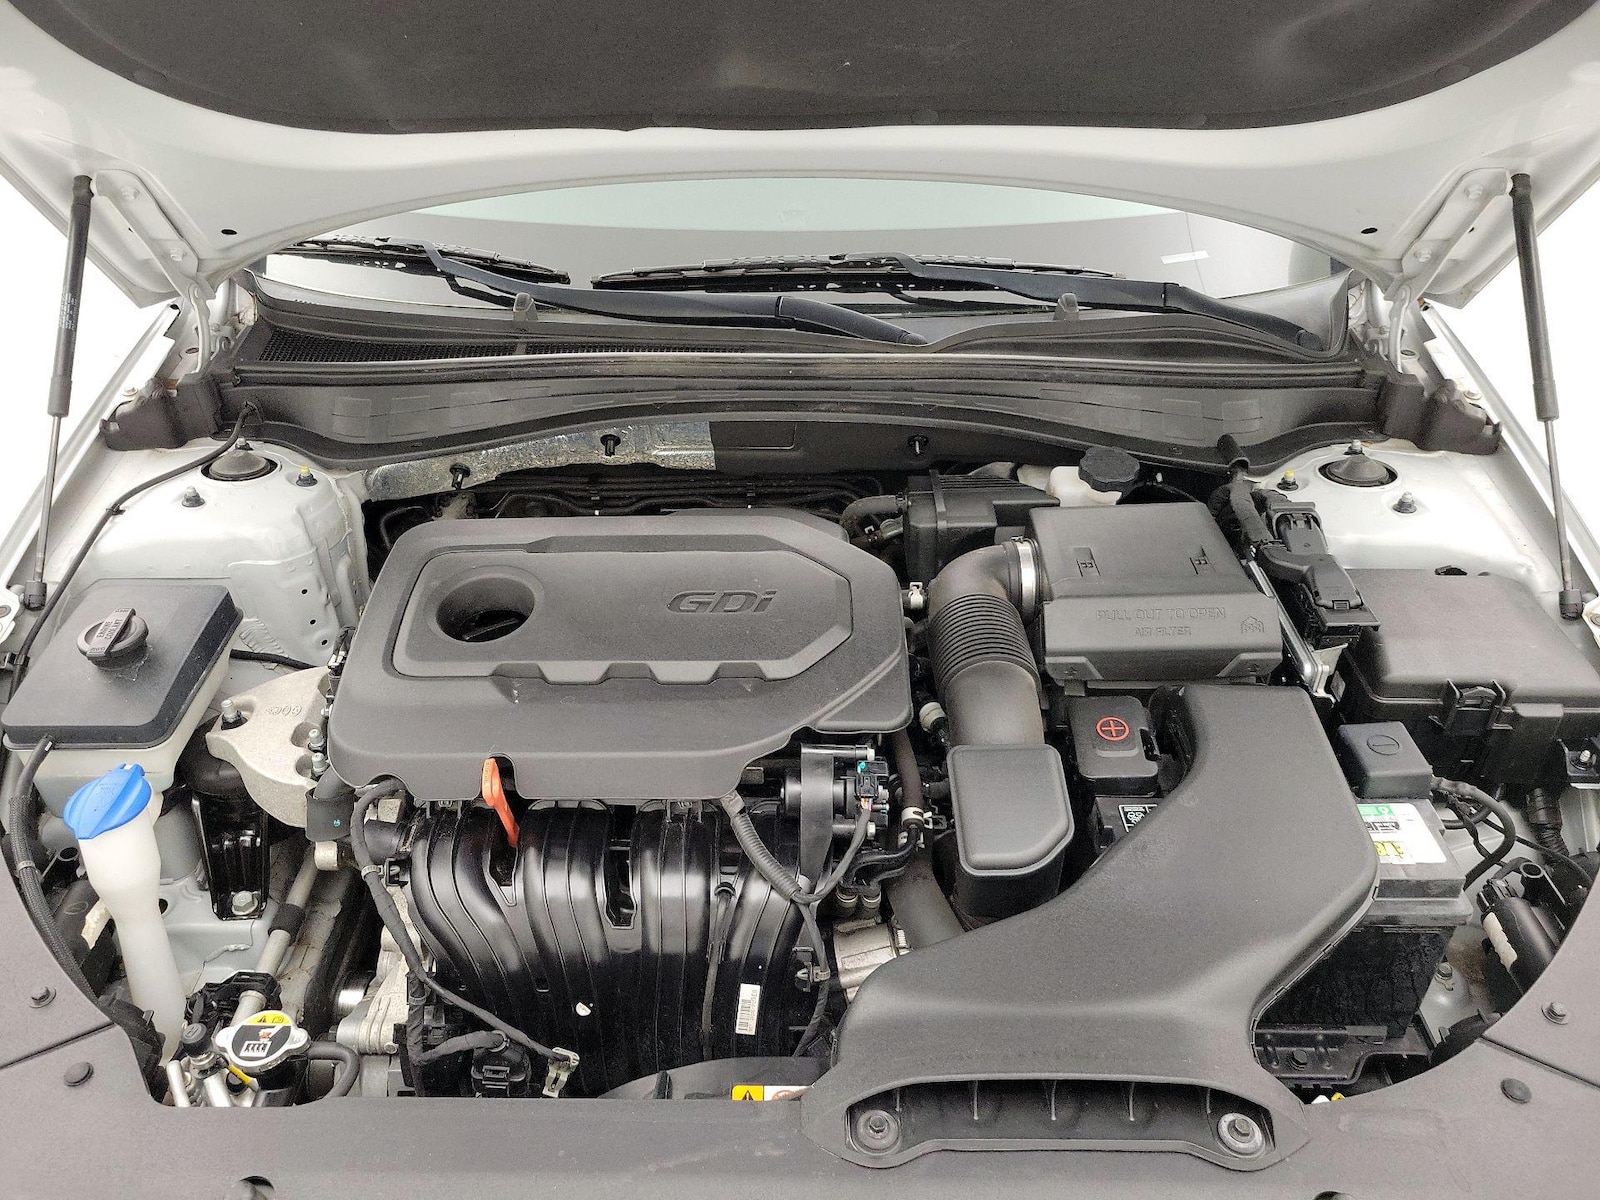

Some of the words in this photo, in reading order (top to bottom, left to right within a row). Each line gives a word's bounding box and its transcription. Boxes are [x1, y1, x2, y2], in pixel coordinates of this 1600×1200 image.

[1096, 609, 1132, 621] PULL
[1134, 608, 1162, 621] OUT
[1166, 608, 1186, 620] TO
[1188, 606, 1227, 620] OPEN
[1135, 626, 1152, 637] AIR
[1155, 626, 1193, 637] FILTER
